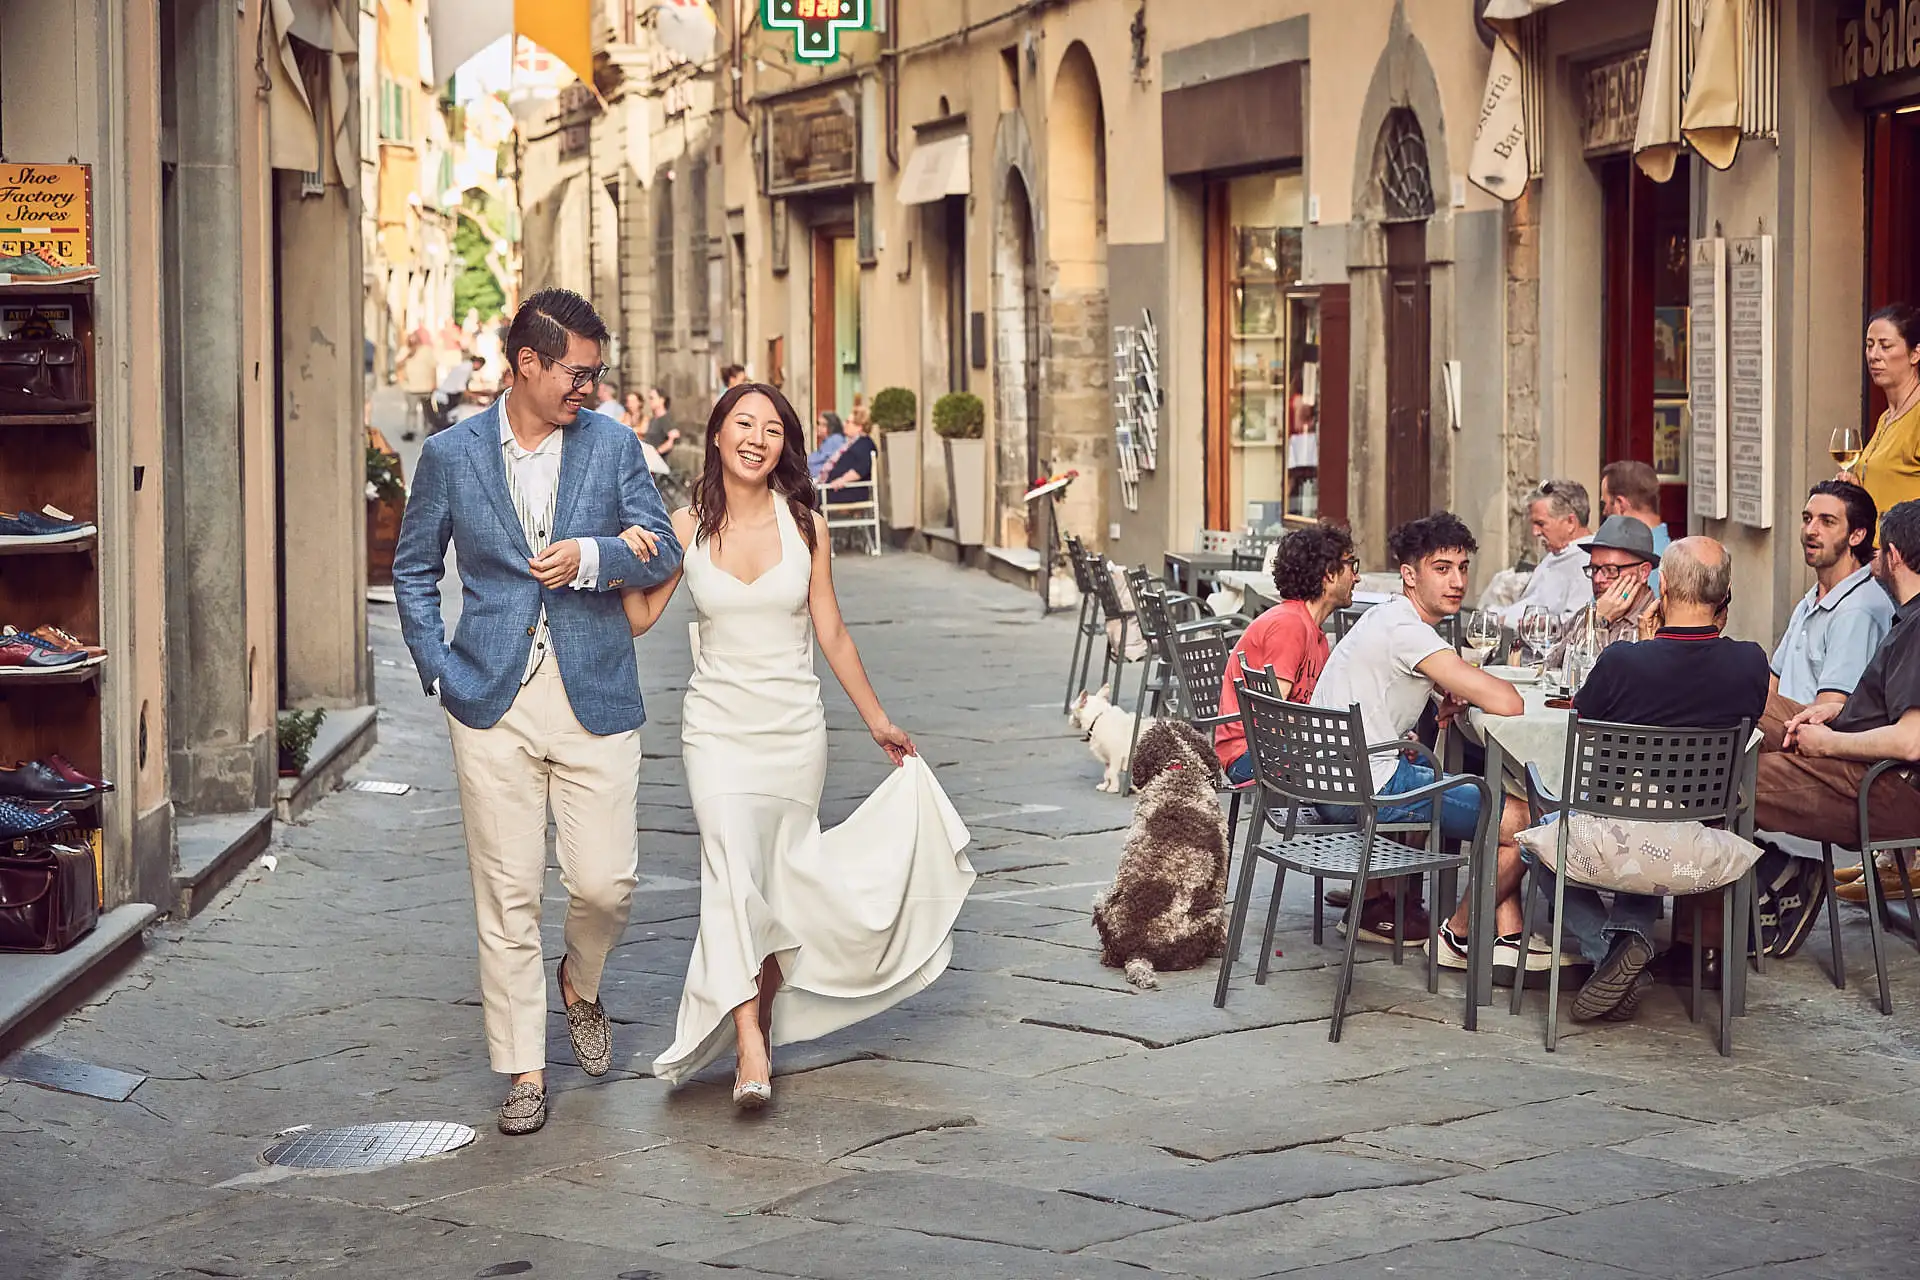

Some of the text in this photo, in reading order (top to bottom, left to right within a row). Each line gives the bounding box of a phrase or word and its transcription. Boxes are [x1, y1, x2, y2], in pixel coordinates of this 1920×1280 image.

[1494, 124, 1524, 159] Bar
[8, 167, 60, 184] Shoe
[0, 186, 78, 208] Factory
[6, 204, 71, 221] Stores
